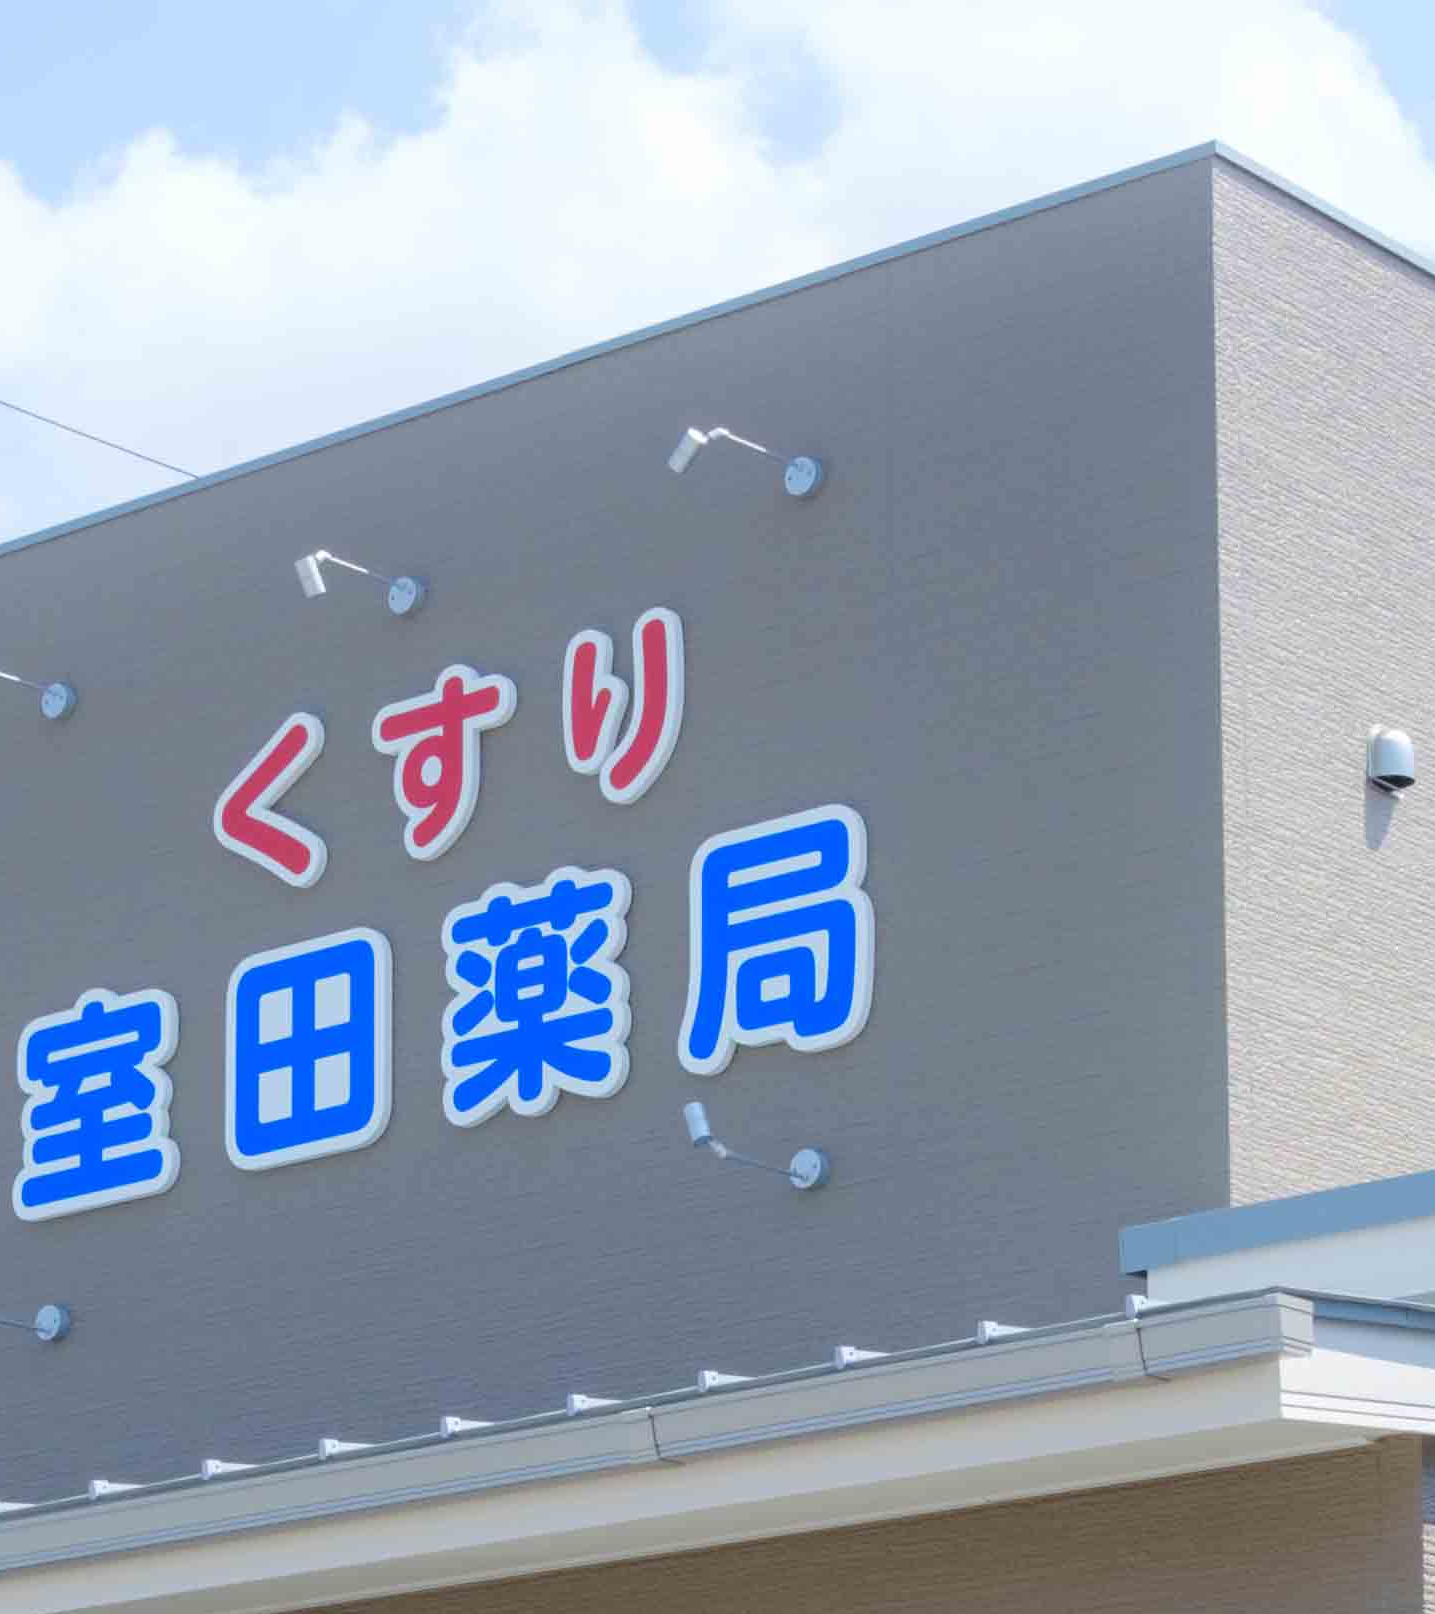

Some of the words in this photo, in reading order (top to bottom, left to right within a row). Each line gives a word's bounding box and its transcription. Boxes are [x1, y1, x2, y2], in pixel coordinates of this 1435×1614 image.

[215, 608, 683, 887] くすり
[12, 804, 874, 1222] 室田薬局
